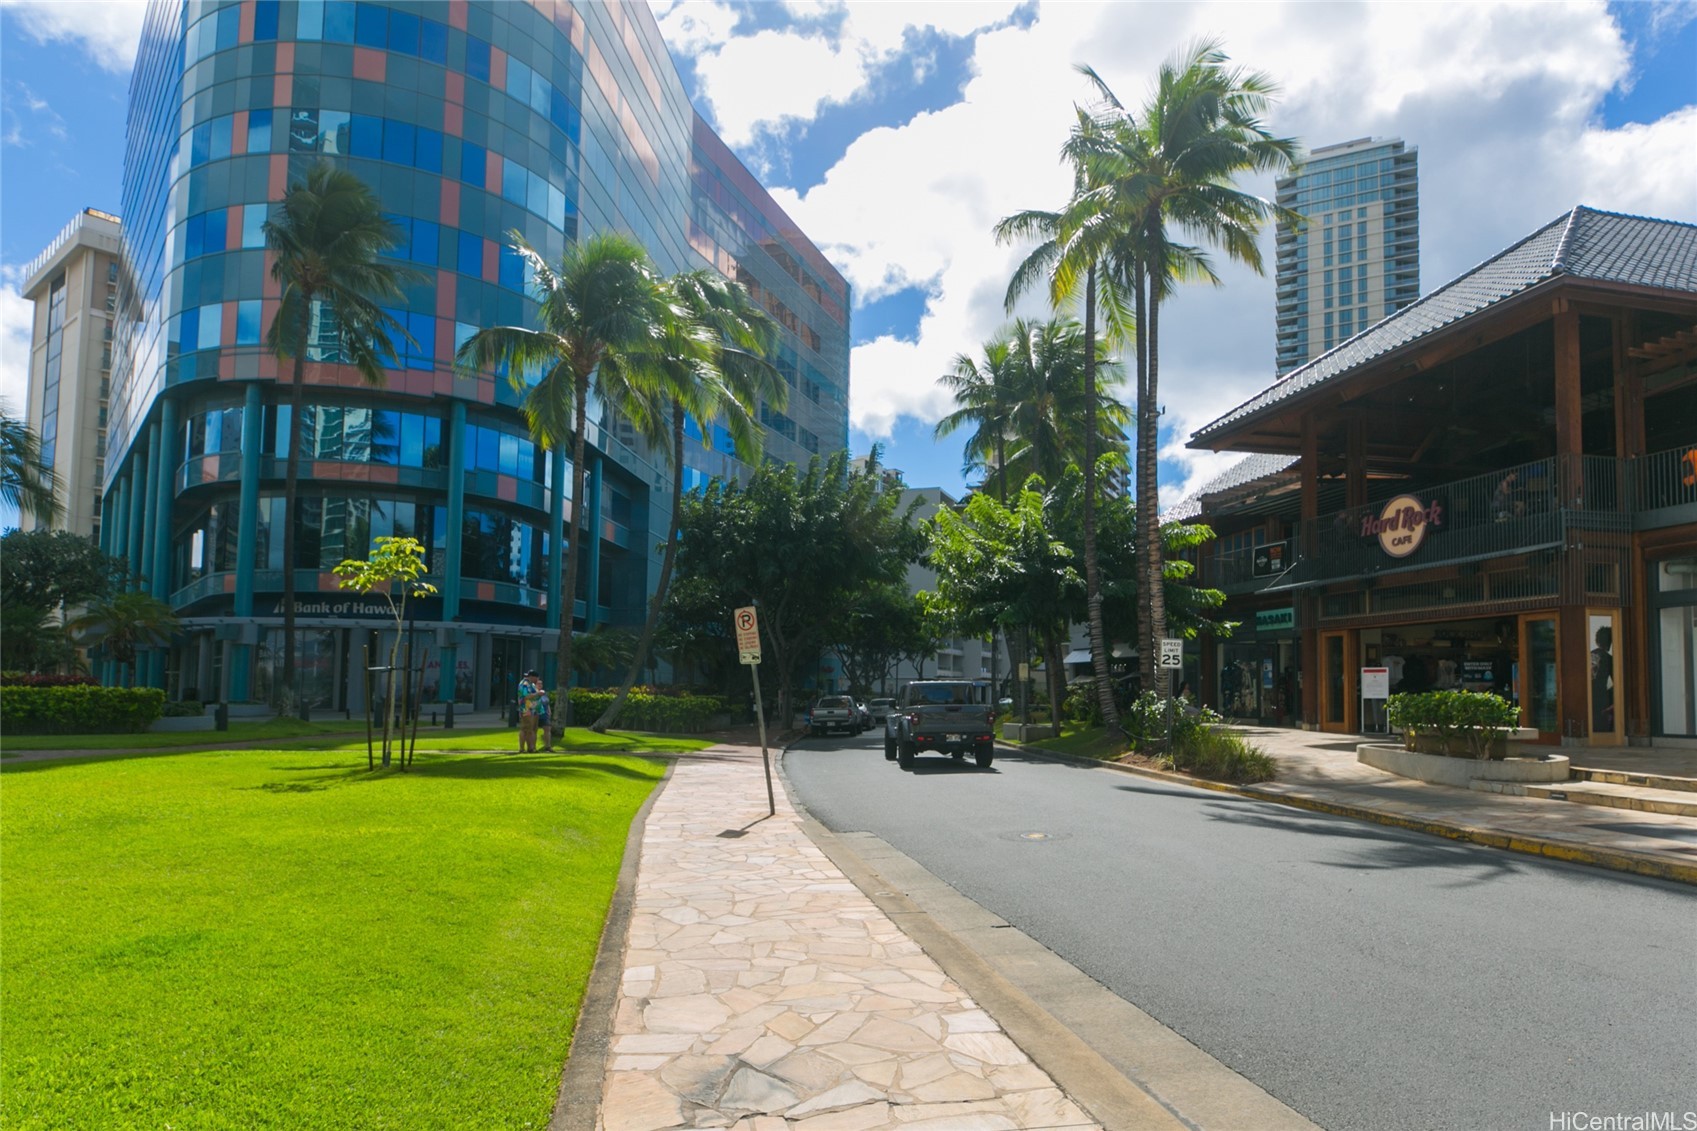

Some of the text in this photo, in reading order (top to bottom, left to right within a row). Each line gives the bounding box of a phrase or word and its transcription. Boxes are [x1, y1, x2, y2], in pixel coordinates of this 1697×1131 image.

[1361, 500, 1441, 536] Hard Rock
[1392, 535, 1413, 547] CAFE
[293, 601, 404, 615] Bank of Hawai
[1162, 654, 1180, 665] 25
